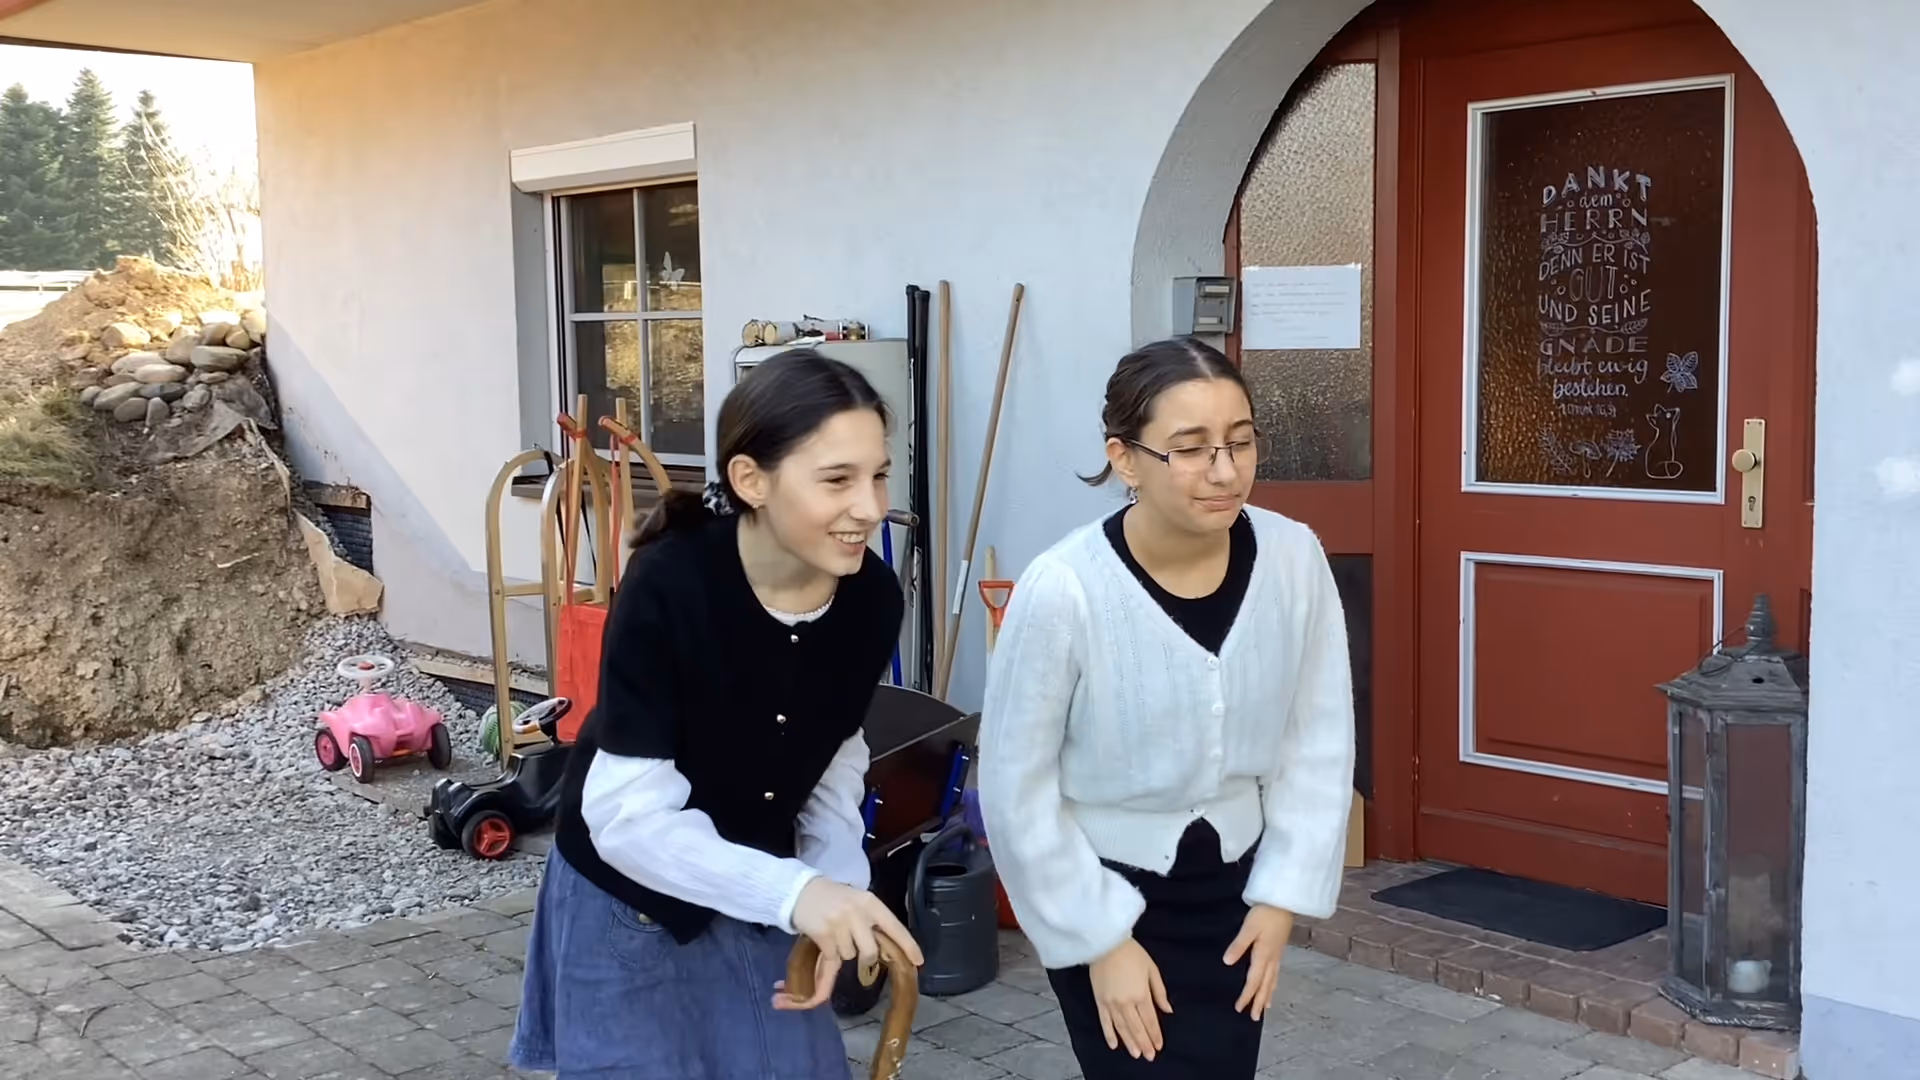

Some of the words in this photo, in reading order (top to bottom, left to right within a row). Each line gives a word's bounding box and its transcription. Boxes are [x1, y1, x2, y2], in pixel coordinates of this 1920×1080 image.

[1542, 166, 1652, 207] DANKT
[1579, 191, 1613, 208] dem
[1540, 208, 1648, 233] HERRN
[1539, 248, 1583, 281] DENN
[1592, 243, 1616, 263] ER
[1623, 249, 1651, 274] IST
[1569, 265, 1619, 303] GUT
[1538, 294, 1577, 323] UND
[1588, 289, 1651, 326] SEINE
[1539, 336, 1649, 355] GNADE
[1598, 358, 1649, 385] ewig
[1552, 378, 1629, 400] bestehen.
